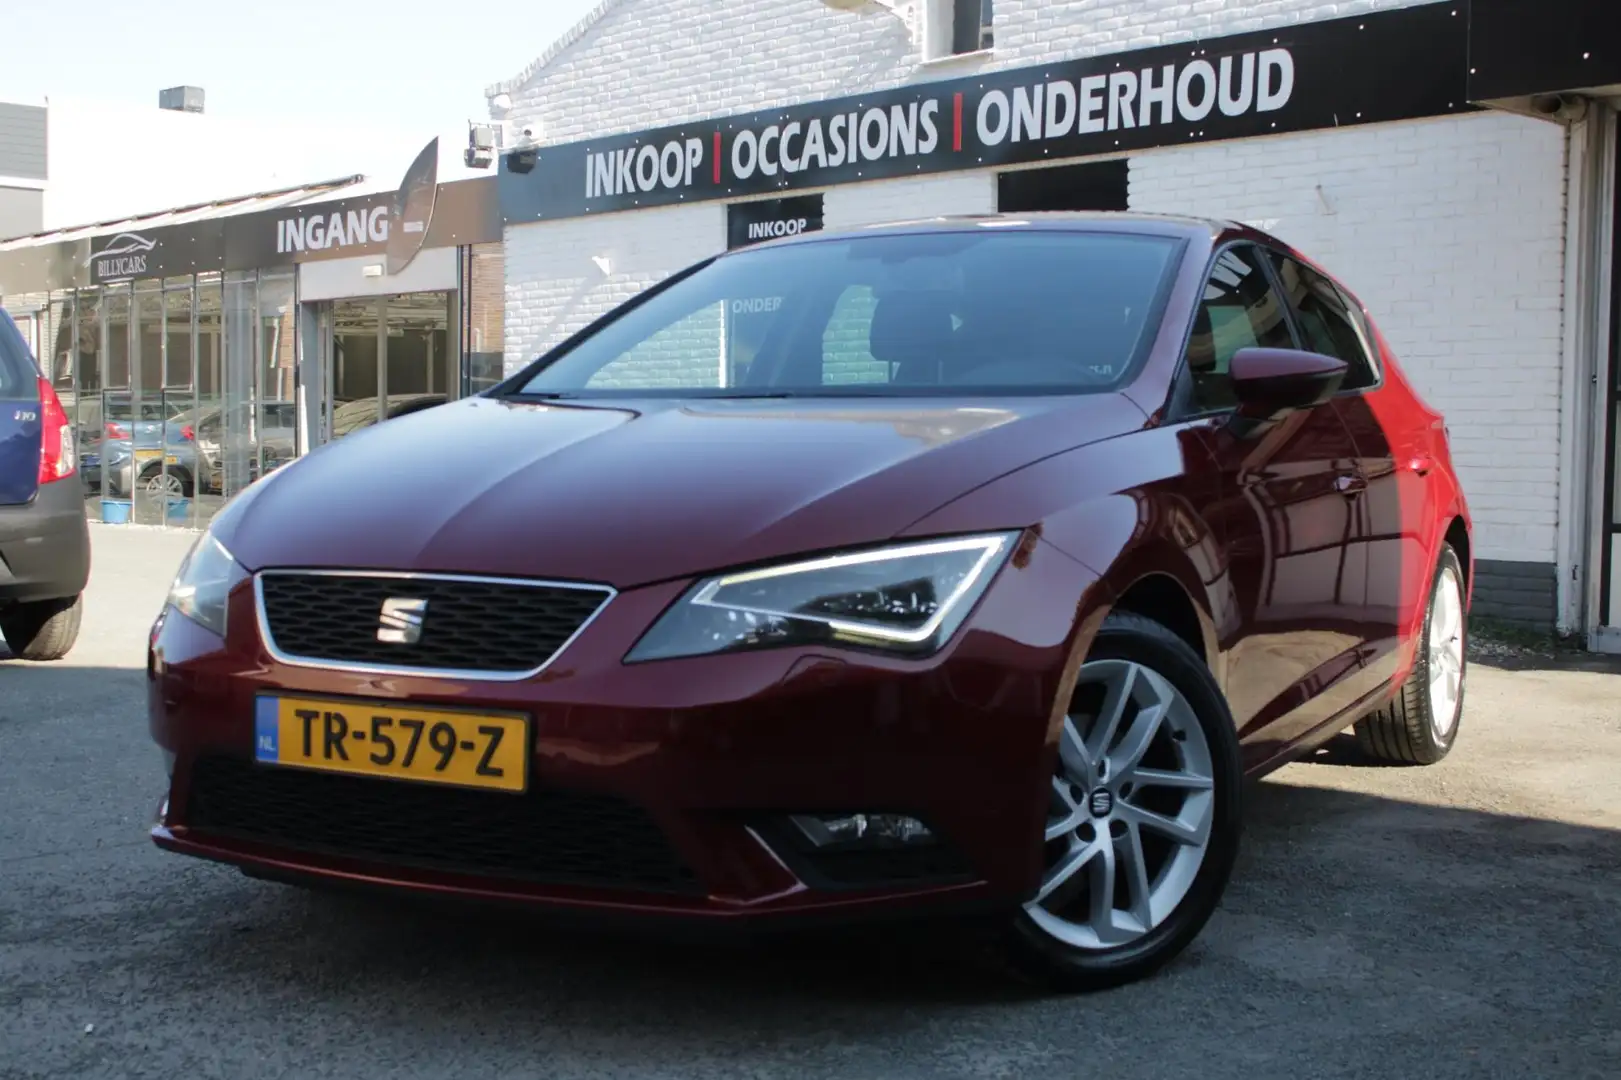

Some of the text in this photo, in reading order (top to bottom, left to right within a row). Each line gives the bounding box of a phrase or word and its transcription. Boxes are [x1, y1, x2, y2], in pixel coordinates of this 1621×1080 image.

[585, 48, 1295, 199] INKOOP OCCASIONS ONDERHOUD
[277, 206, 389, 253] INGANG
[748, 218, 808, 239] INKOOP
[98, 255, 147, 277] BILLYCARS
[258, 735, 277, 752] NL
[294, 709, 505, 778] TR-579-Z
